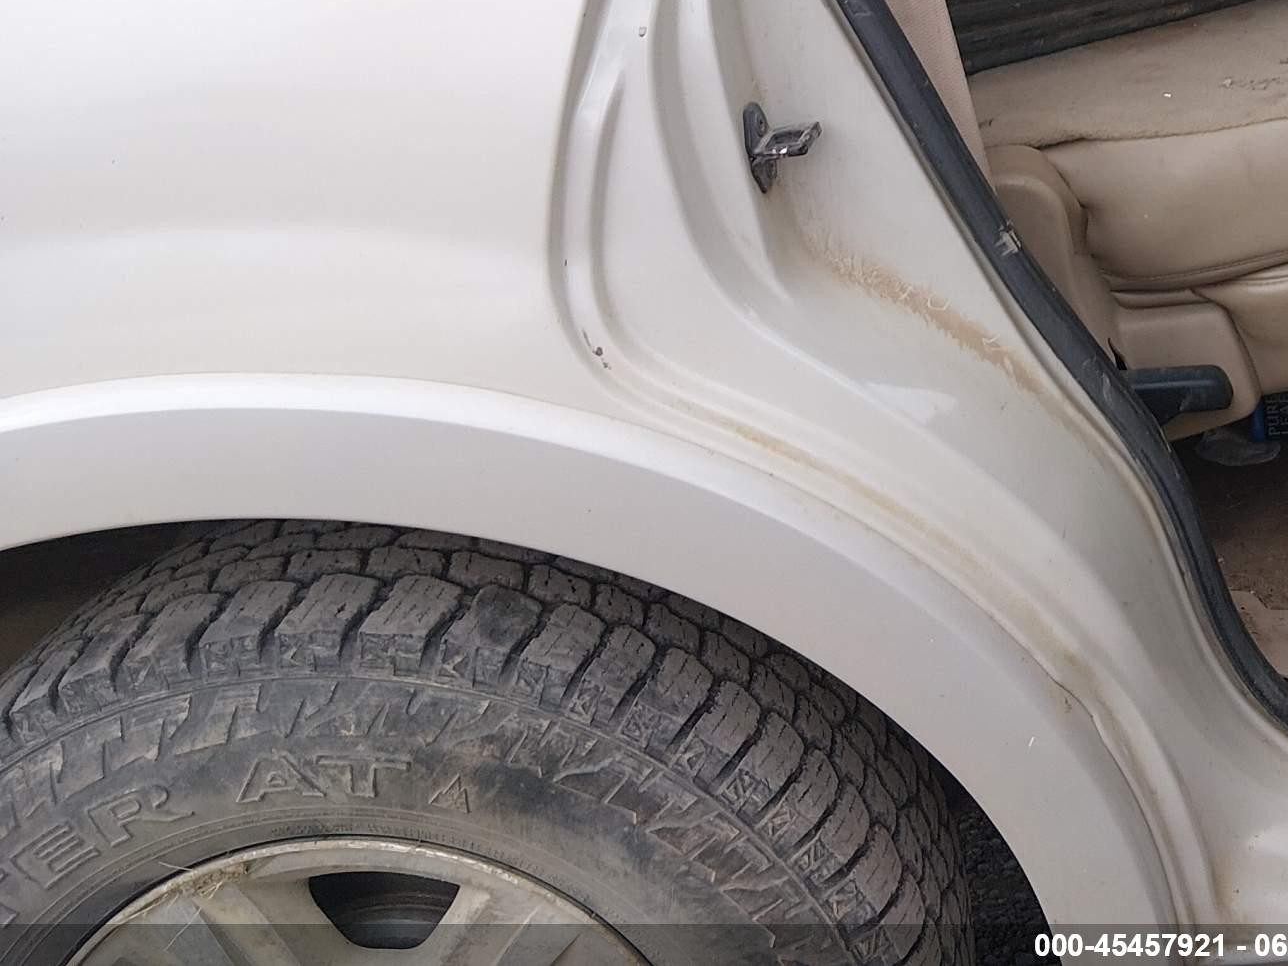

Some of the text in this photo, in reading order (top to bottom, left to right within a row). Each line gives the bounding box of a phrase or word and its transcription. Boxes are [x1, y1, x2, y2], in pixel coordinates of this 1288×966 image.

[1266, 395, 1280, 436] PURE
[0, 784, 195, 927] ER
[235, 748, 413, 803] AT
